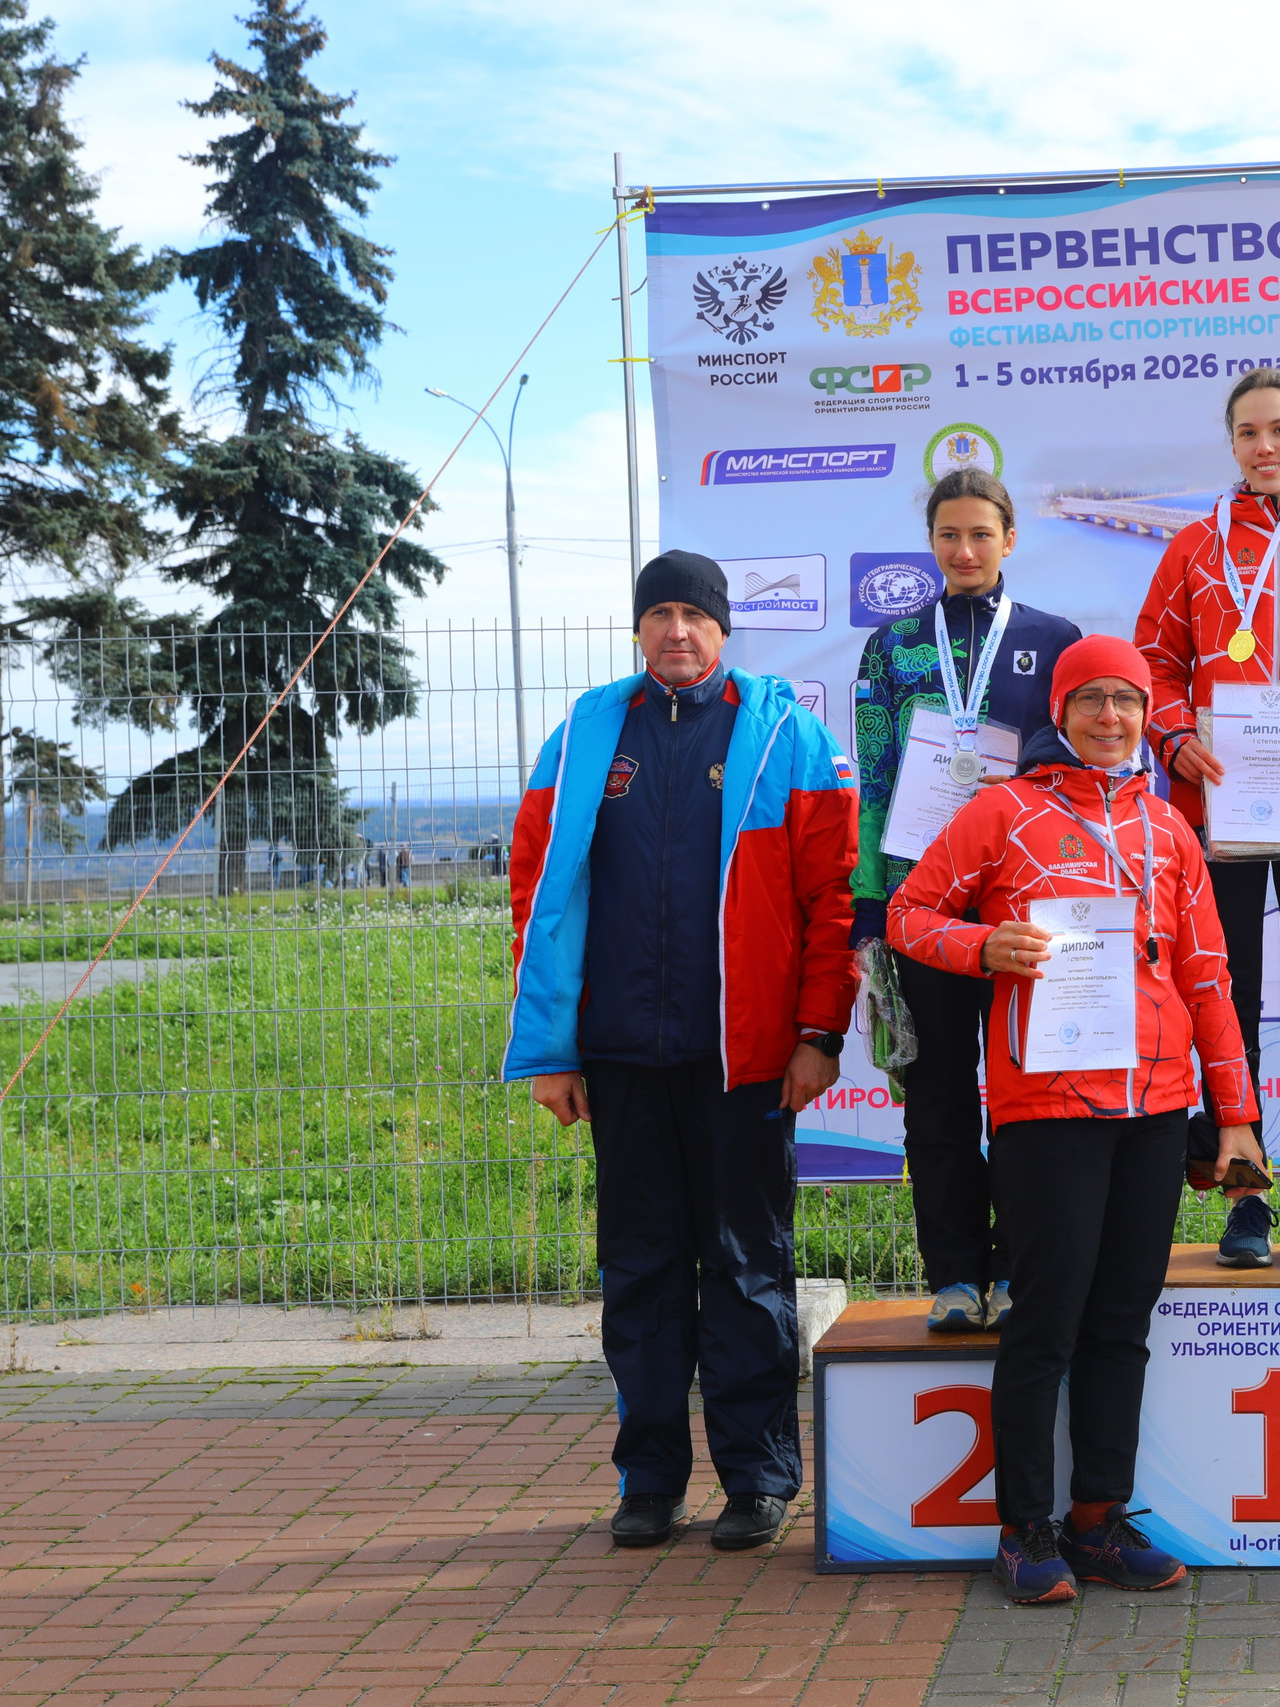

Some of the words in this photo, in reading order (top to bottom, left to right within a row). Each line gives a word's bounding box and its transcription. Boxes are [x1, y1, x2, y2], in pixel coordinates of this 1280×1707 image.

[948, 274, 1251, 316] ВСЕРОССИЙСКИЕ
[949, 321, 1104, 348] ФЕСТИВАЛЬ
[698, 351, 787, 368] МИНСПОРТ
[710, 372, 778, 386] РОССИИ
[955, 363, 969, 388] 1
[996, 362, 1013, 386] 5
[1020, 358, 1136, 389] октября
[1143, 353, 1219, 380] 2026
[814, 398, 866, 407] ФЕДЕРАЦИЯ
[868, 396, 931, 405] СПОРТИВНОГО
[814, 405, 893, 414] ОРИЕНТИРОВАНИЯ
[726, 450, 888, 471] МИНСПОРТ
[858, 577, 870, 603] РУССКОЕ
[867, 563, 922, 579] ГЕОГРАФИЧЕСКОЕ
[921, 571, 937, 598] ОБЩЕСТВО
[867, 605, 900, 615] ОСНОВАНО
[1048, 861, 1098, 871] ВЛАДИМИРСКАЯ
[1060, 940, 1104, 954] ДИПЛОМ
[1157, 1302, 1269, 1318] ФЕДЕРАЦИЯ
[911, 1384, 997, 1529] 2
